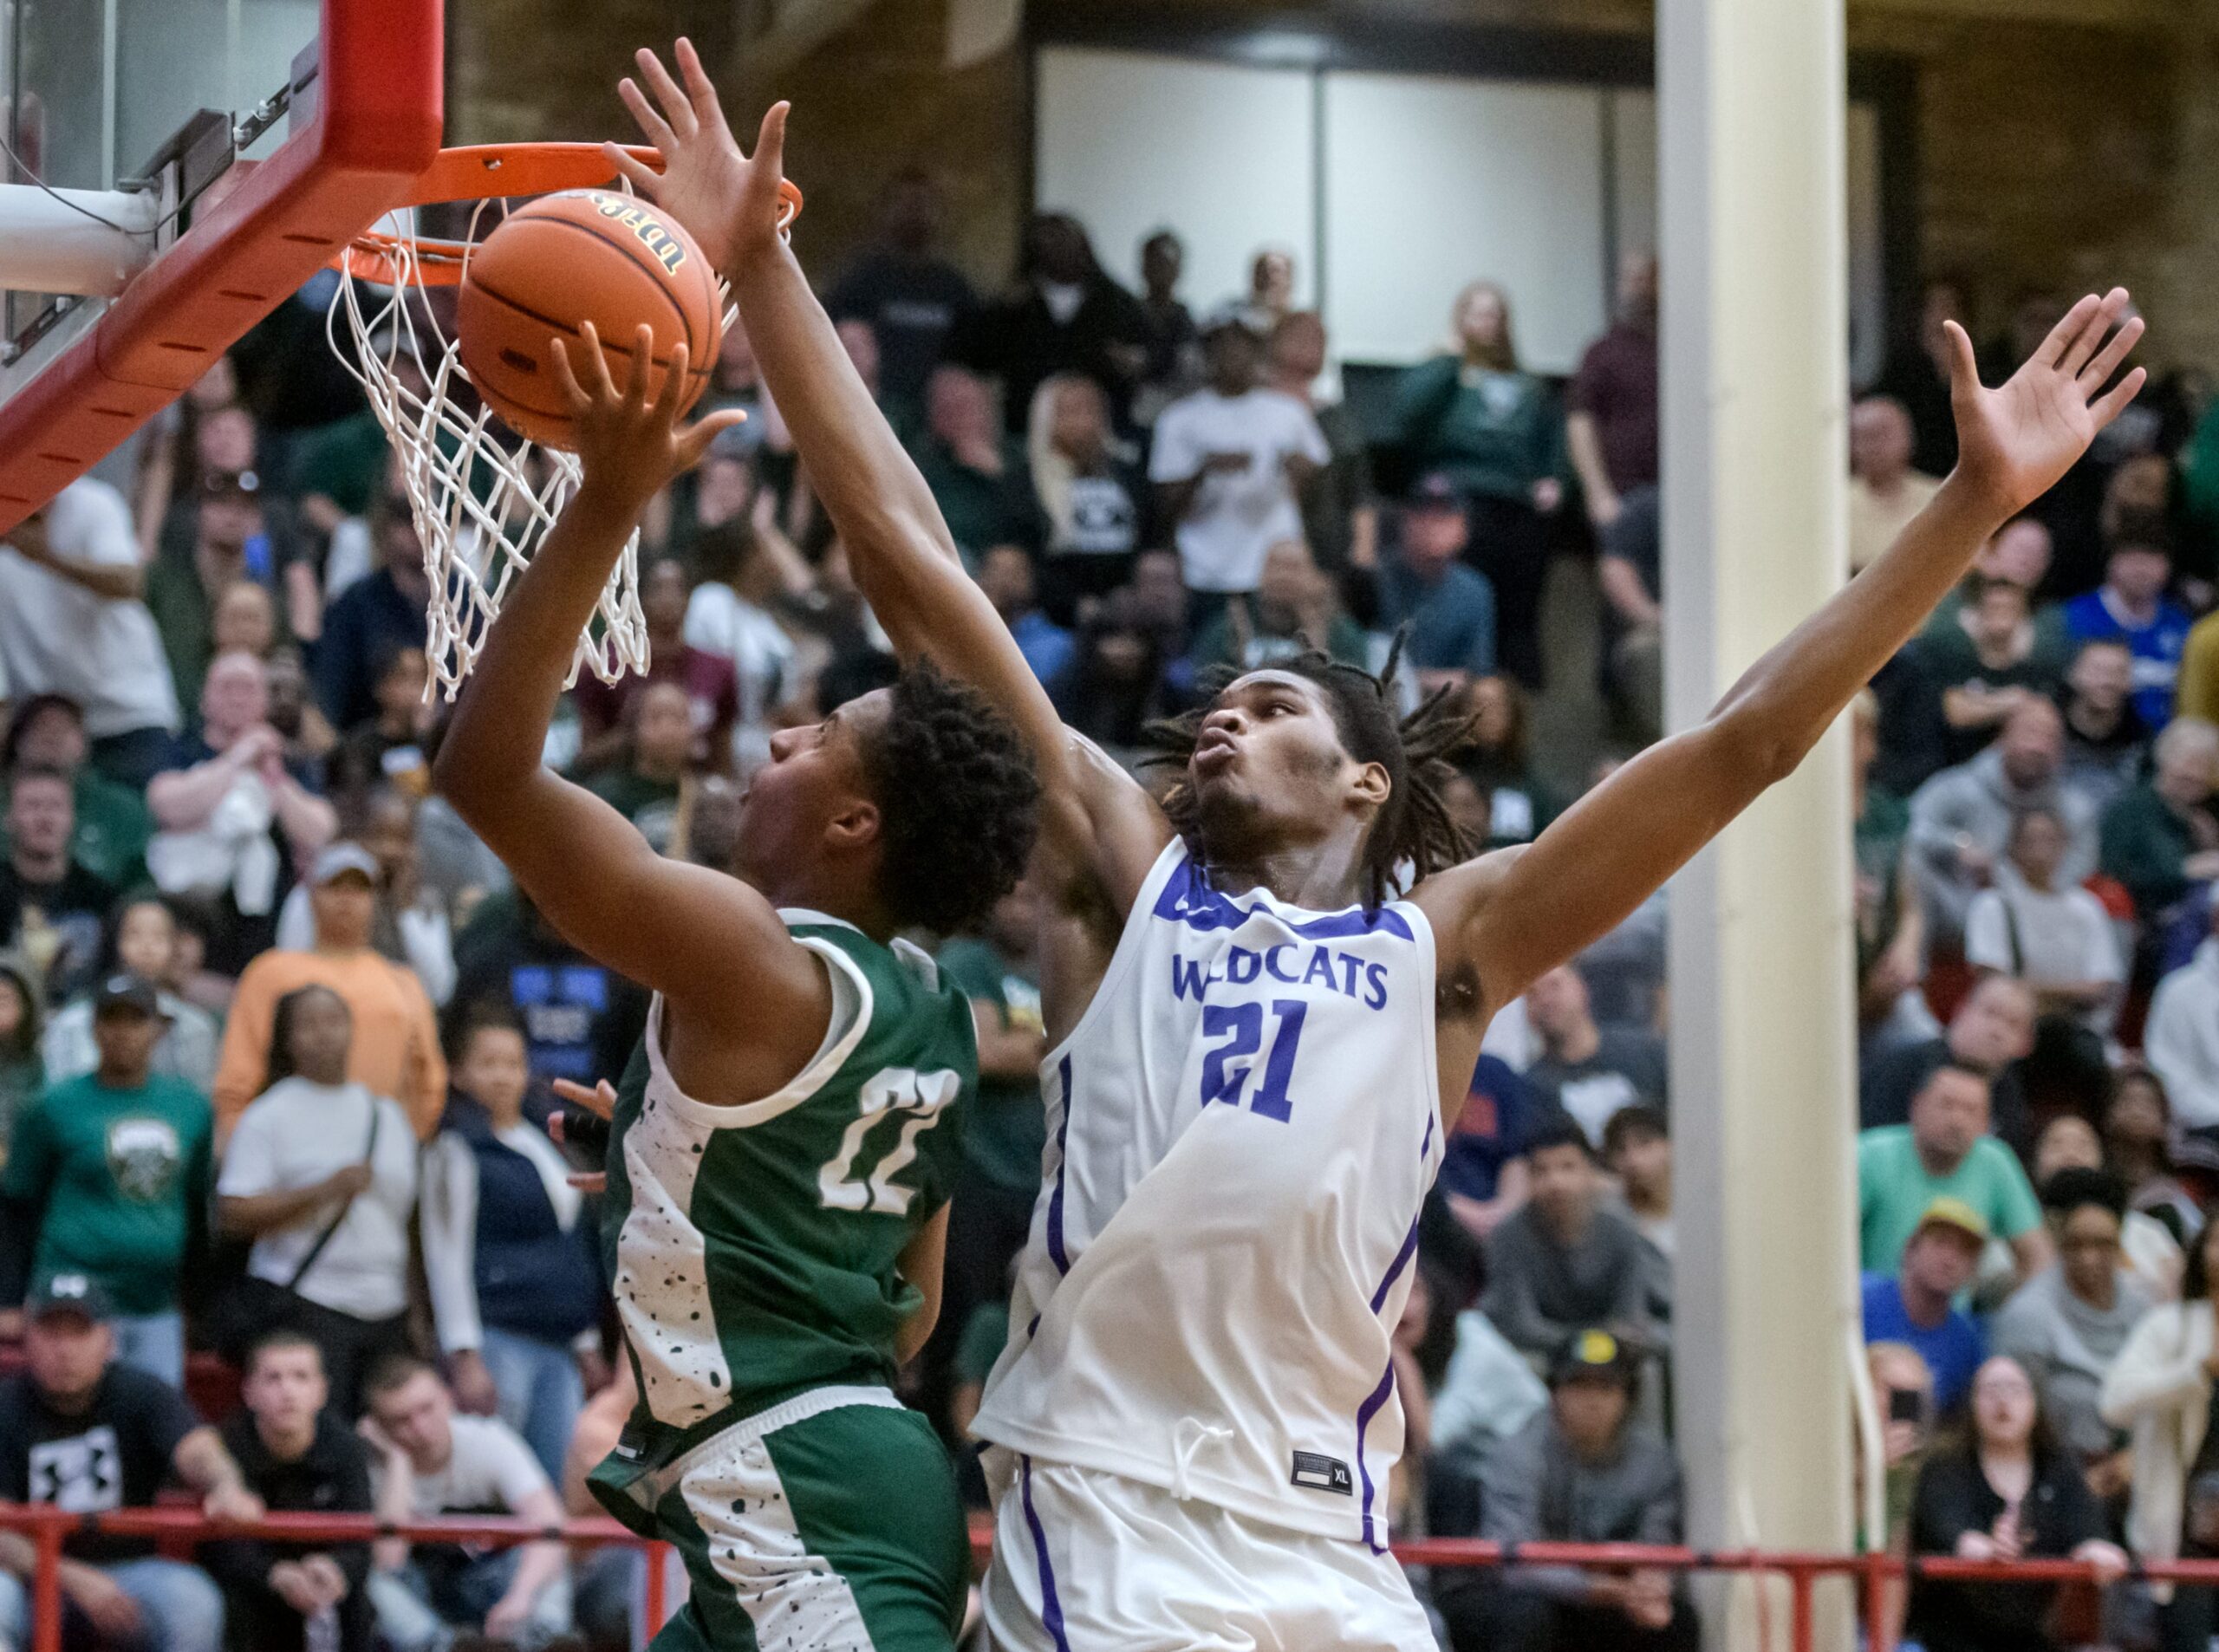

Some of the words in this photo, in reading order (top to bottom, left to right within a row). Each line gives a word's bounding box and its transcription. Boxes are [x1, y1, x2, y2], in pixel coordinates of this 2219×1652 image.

[1201, 999, 1308, 1124] 21
[818, 1067, 961, 1218] 22
[1334, 1468, 1349, 1485] XL
